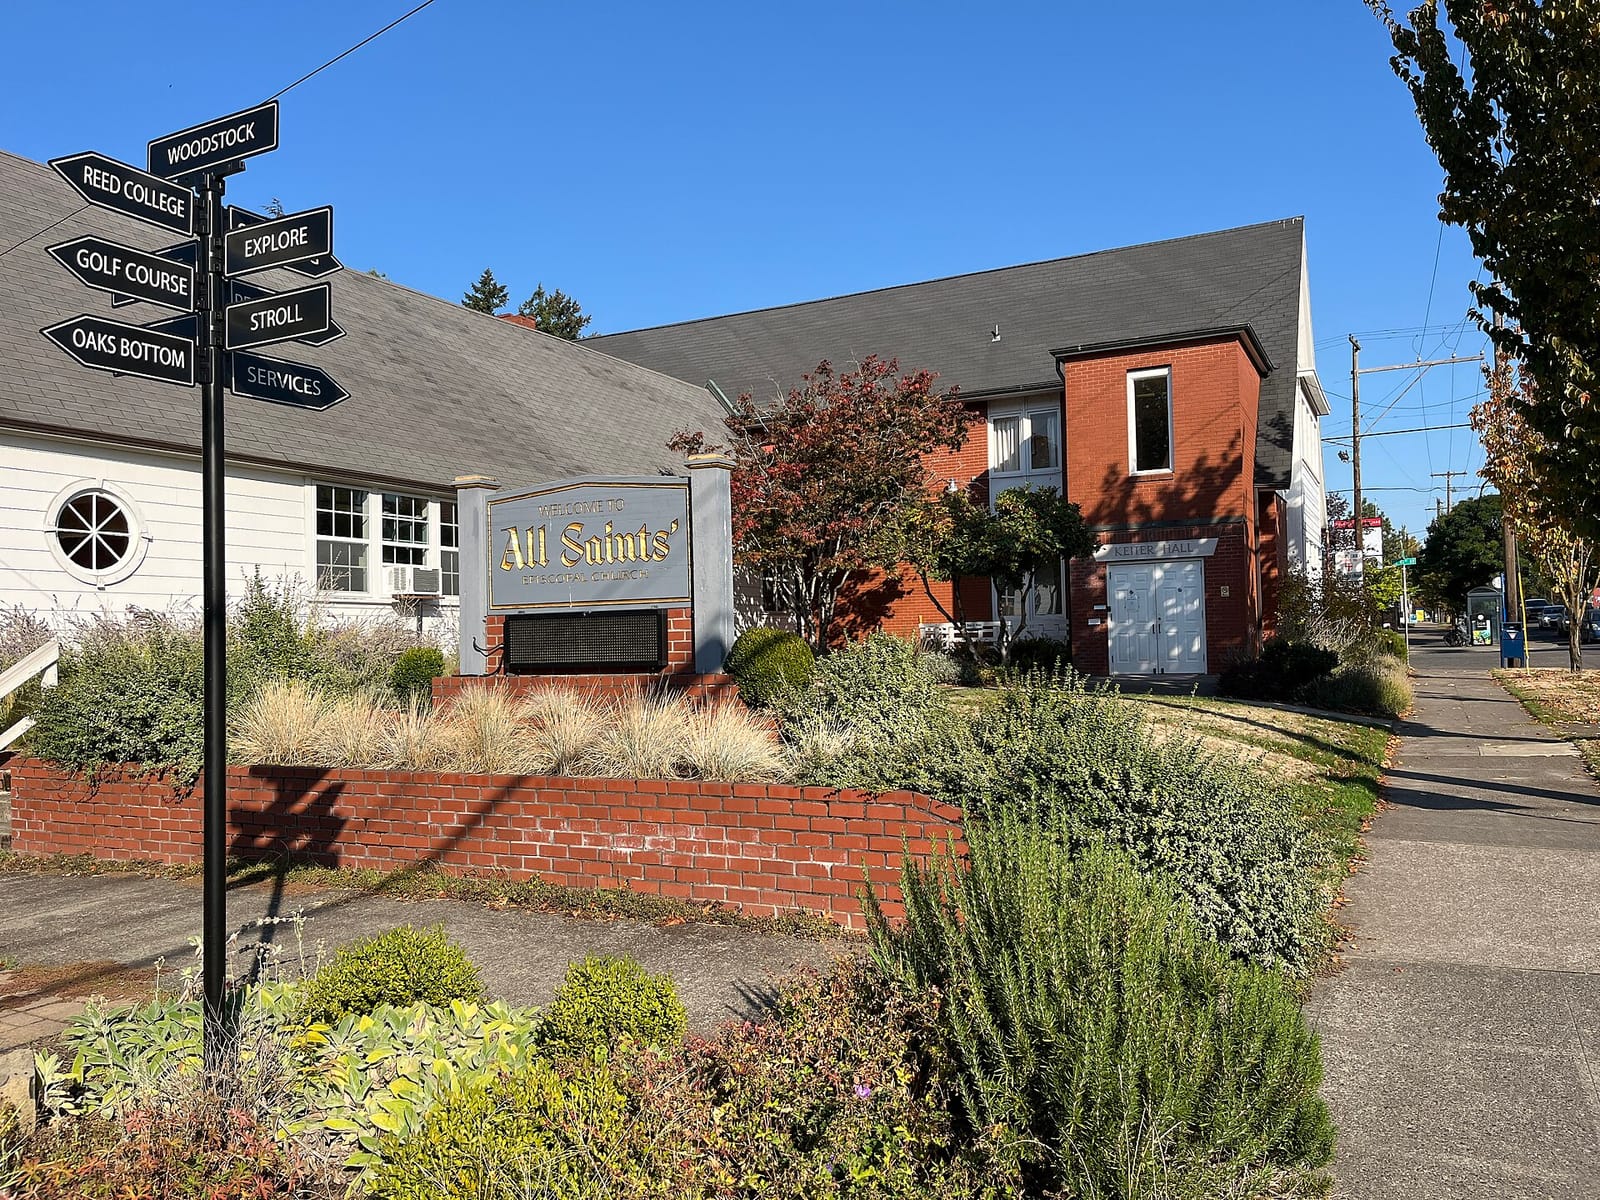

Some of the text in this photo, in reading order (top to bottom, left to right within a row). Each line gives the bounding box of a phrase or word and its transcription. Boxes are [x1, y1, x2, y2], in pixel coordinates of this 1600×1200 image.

[167, 121, 256, 165] WOODSTOCK
[83, 165, 185, 218] REED COLLEGE
[245, 226, 308, 258] EXPLORE
[76, 248, 188, 296] GOLF COURSE
[250, 304, 303, 331] STROLL
[72, 328, 185, 369] OAKS BOTTOM
[247, 366, 321, 396] SERVICES
[538, 498, 625, 517] WELCOME TO
[500, 518, 679, 572] All Saints'
[1163, 543, 1193, 554] HALL
[522, 569, 649, 585] EPISCOPAL CHURCH
